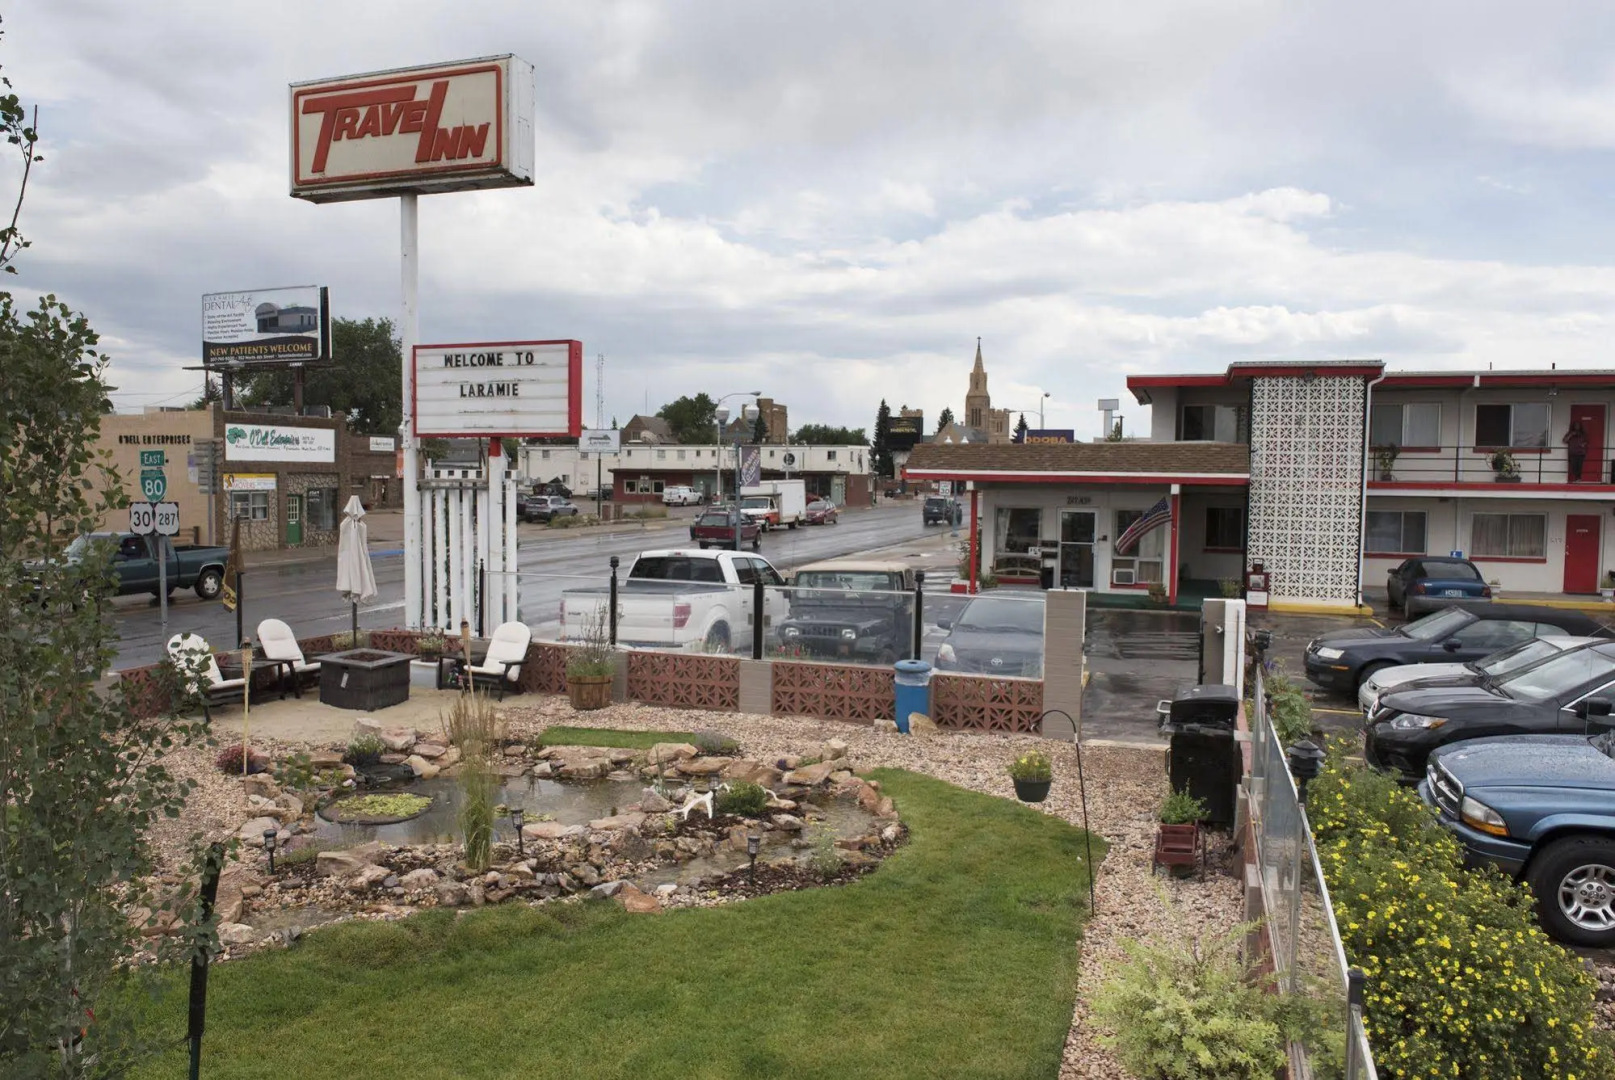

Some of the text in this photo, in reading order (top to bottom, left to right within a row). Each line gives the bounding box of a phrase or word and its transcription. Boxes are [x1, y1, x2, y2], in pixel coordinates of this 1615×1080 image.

[204, 300, 235, 311] DENTAL
[210, 347, 228, 357] NEW
[231, 345, 268, 355] PATIENTS
[270, 343, 313, 353] WELCOME
[444, 352, 534, 367] WELCOME TO
[460, 383, 519, 398] LARAMIE
[143, 434, 191, 445] ENTERPRISES
[144, 453, 161, 465] EAST
[145, 479, 163, 496] 80
[133, 511, 151, 527] 30
[158, 513, 176, 526] 287
